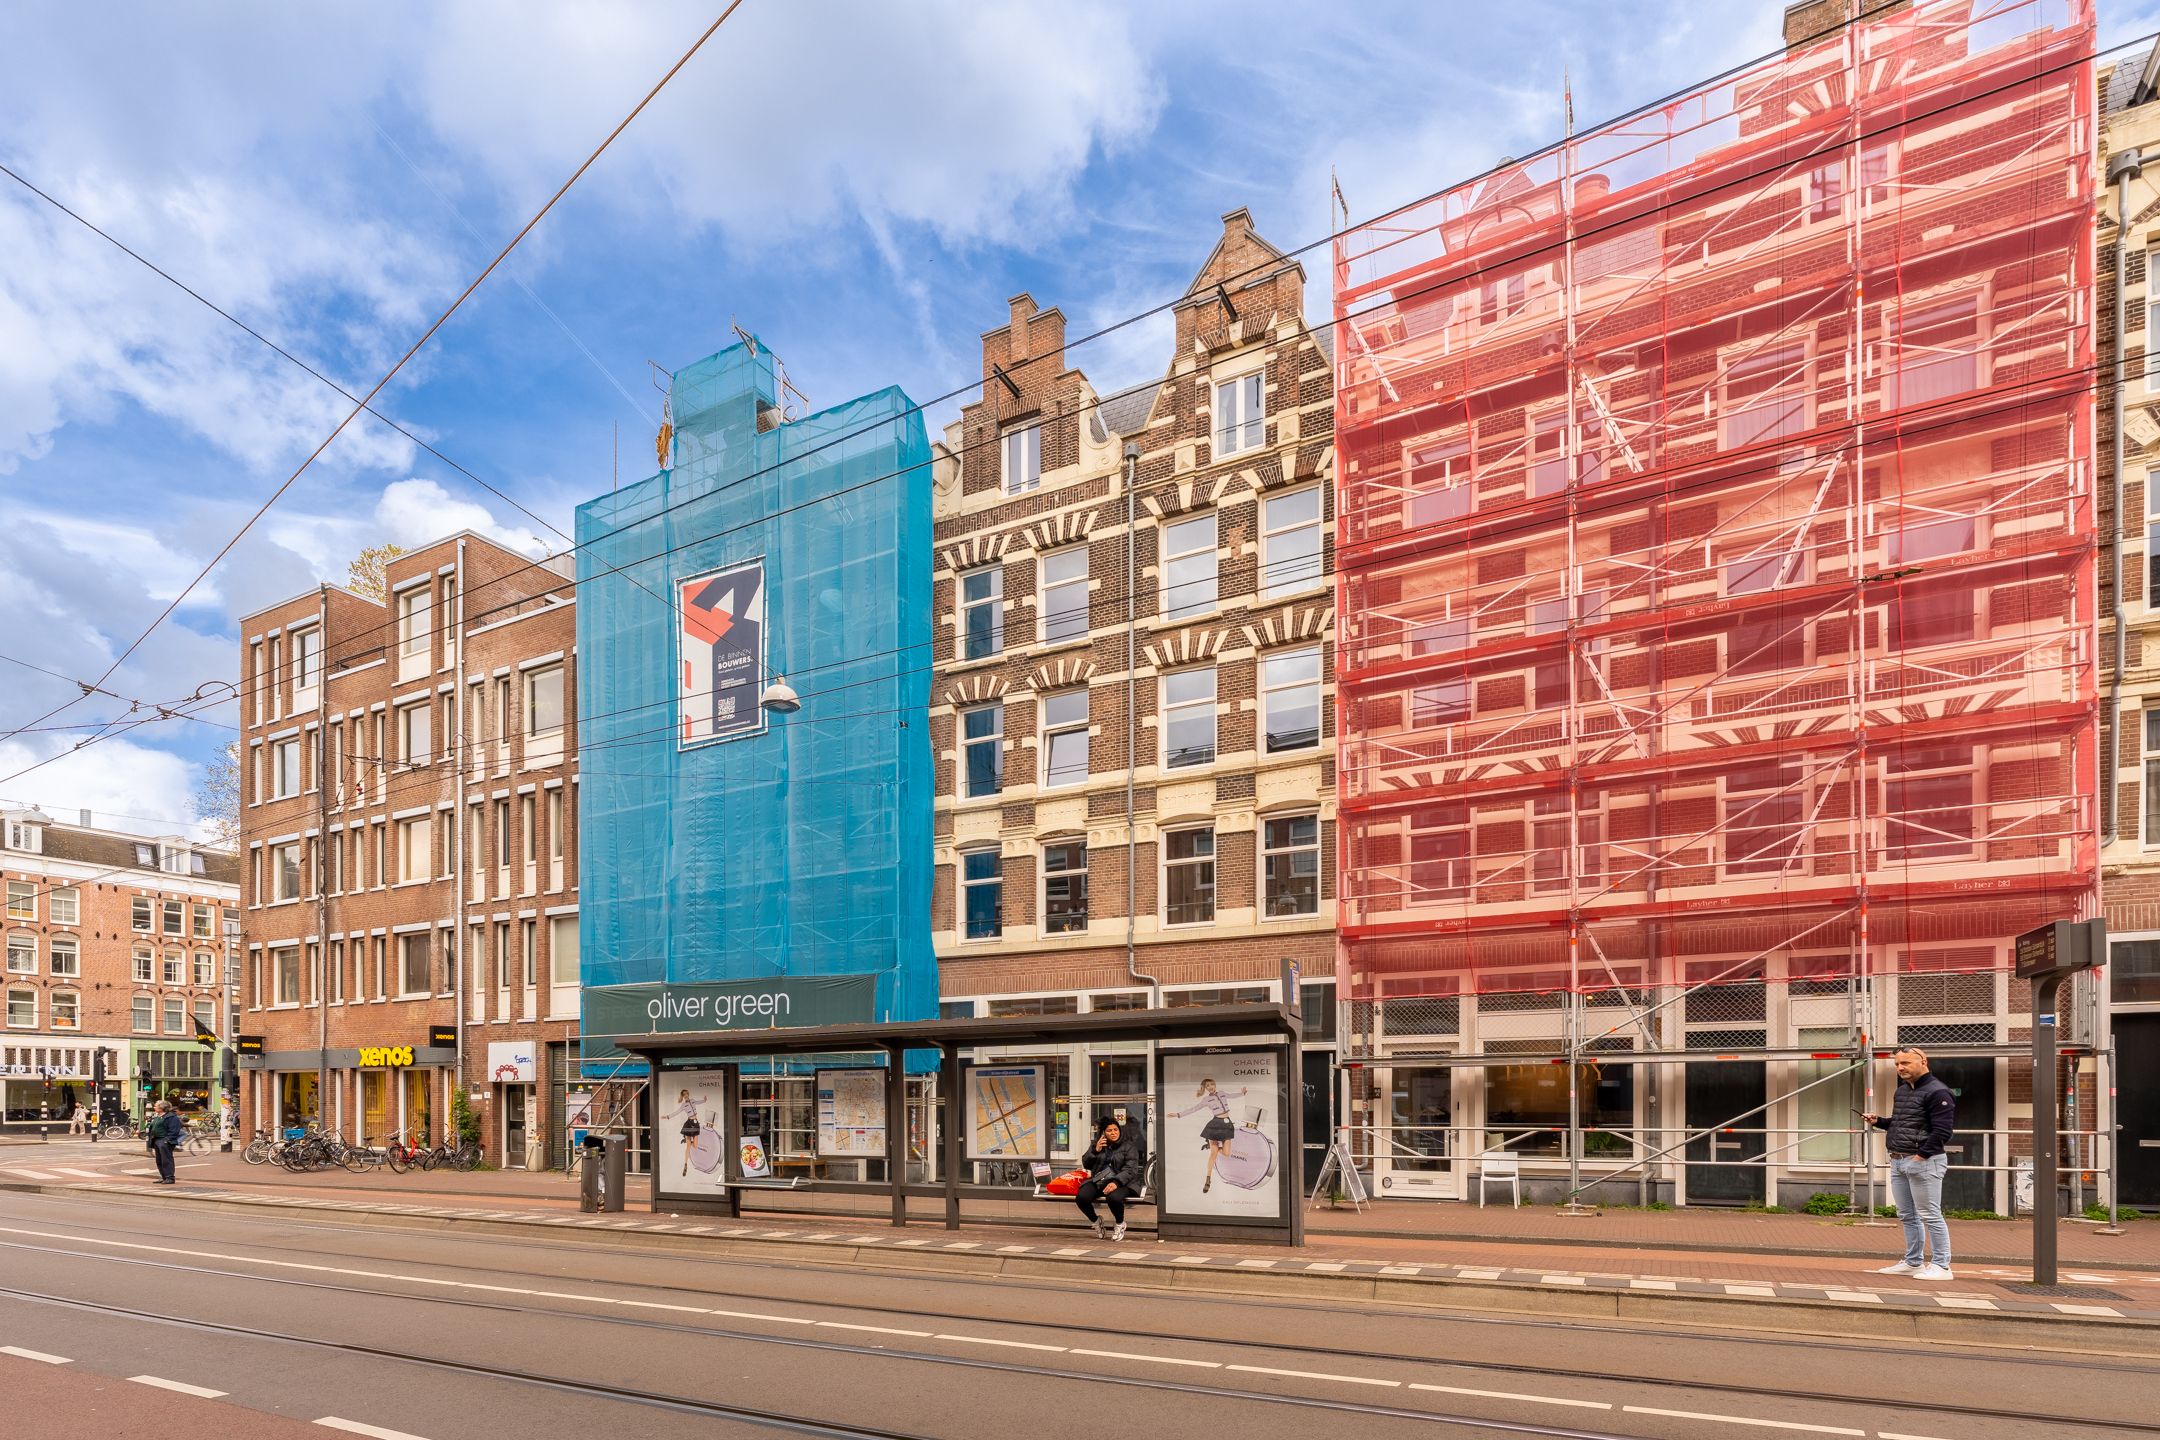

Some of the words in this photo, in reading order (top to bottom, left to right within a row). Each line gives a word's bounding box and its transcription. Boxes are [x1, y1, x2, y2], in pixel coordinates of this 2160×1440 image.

[1953, 881, 1994, 891] Layher
[647, 992, 709, 1020] oliver
[714, 992, 790, 1026] green
[358, 1046, 413, 1067] xenos
[1233, 1058, 1272, 1066] CHANCE
[1233, 1068, 1272, 1076] CHANEL
